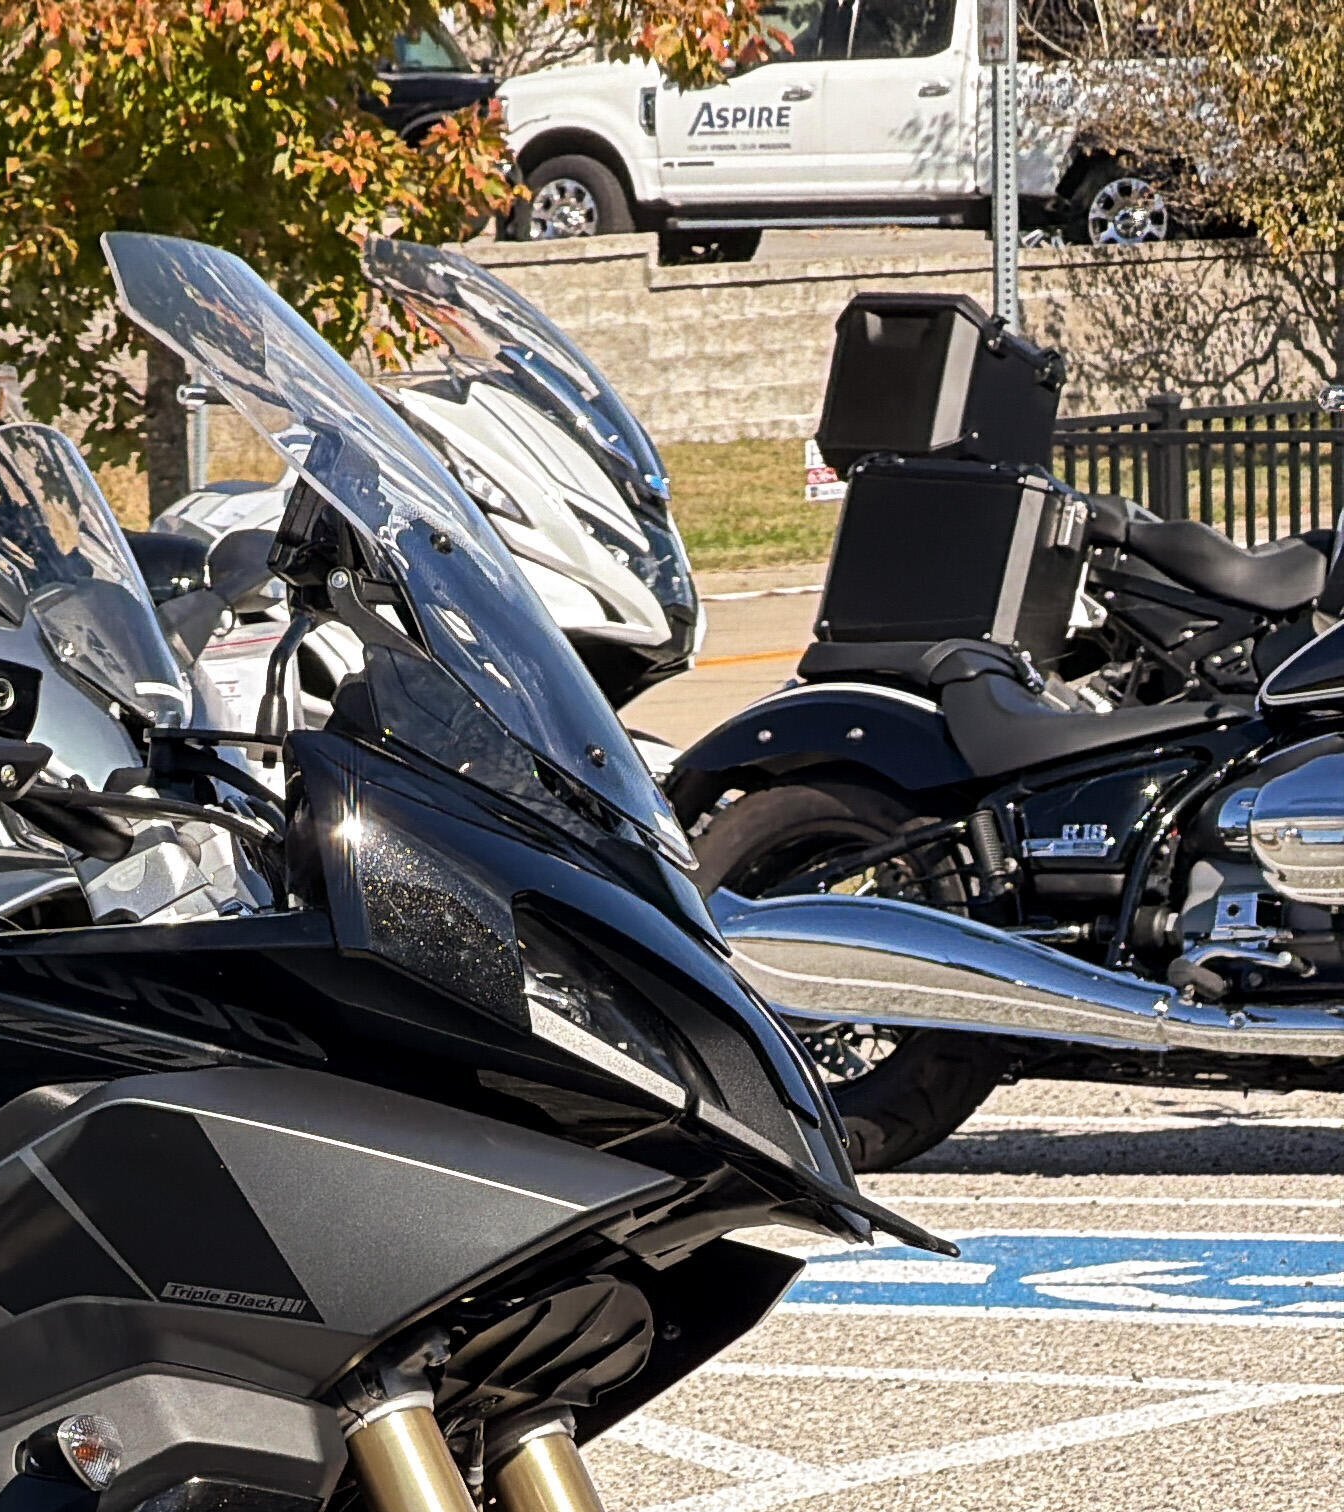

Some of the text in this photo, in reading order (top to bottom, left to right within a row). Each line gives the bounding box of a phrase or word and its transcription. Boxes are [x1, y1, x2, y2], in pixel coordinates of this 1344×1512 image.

[688, 101, 792, 136] ASPIRE
[170, 1284, 276, 1310] Triple Black
